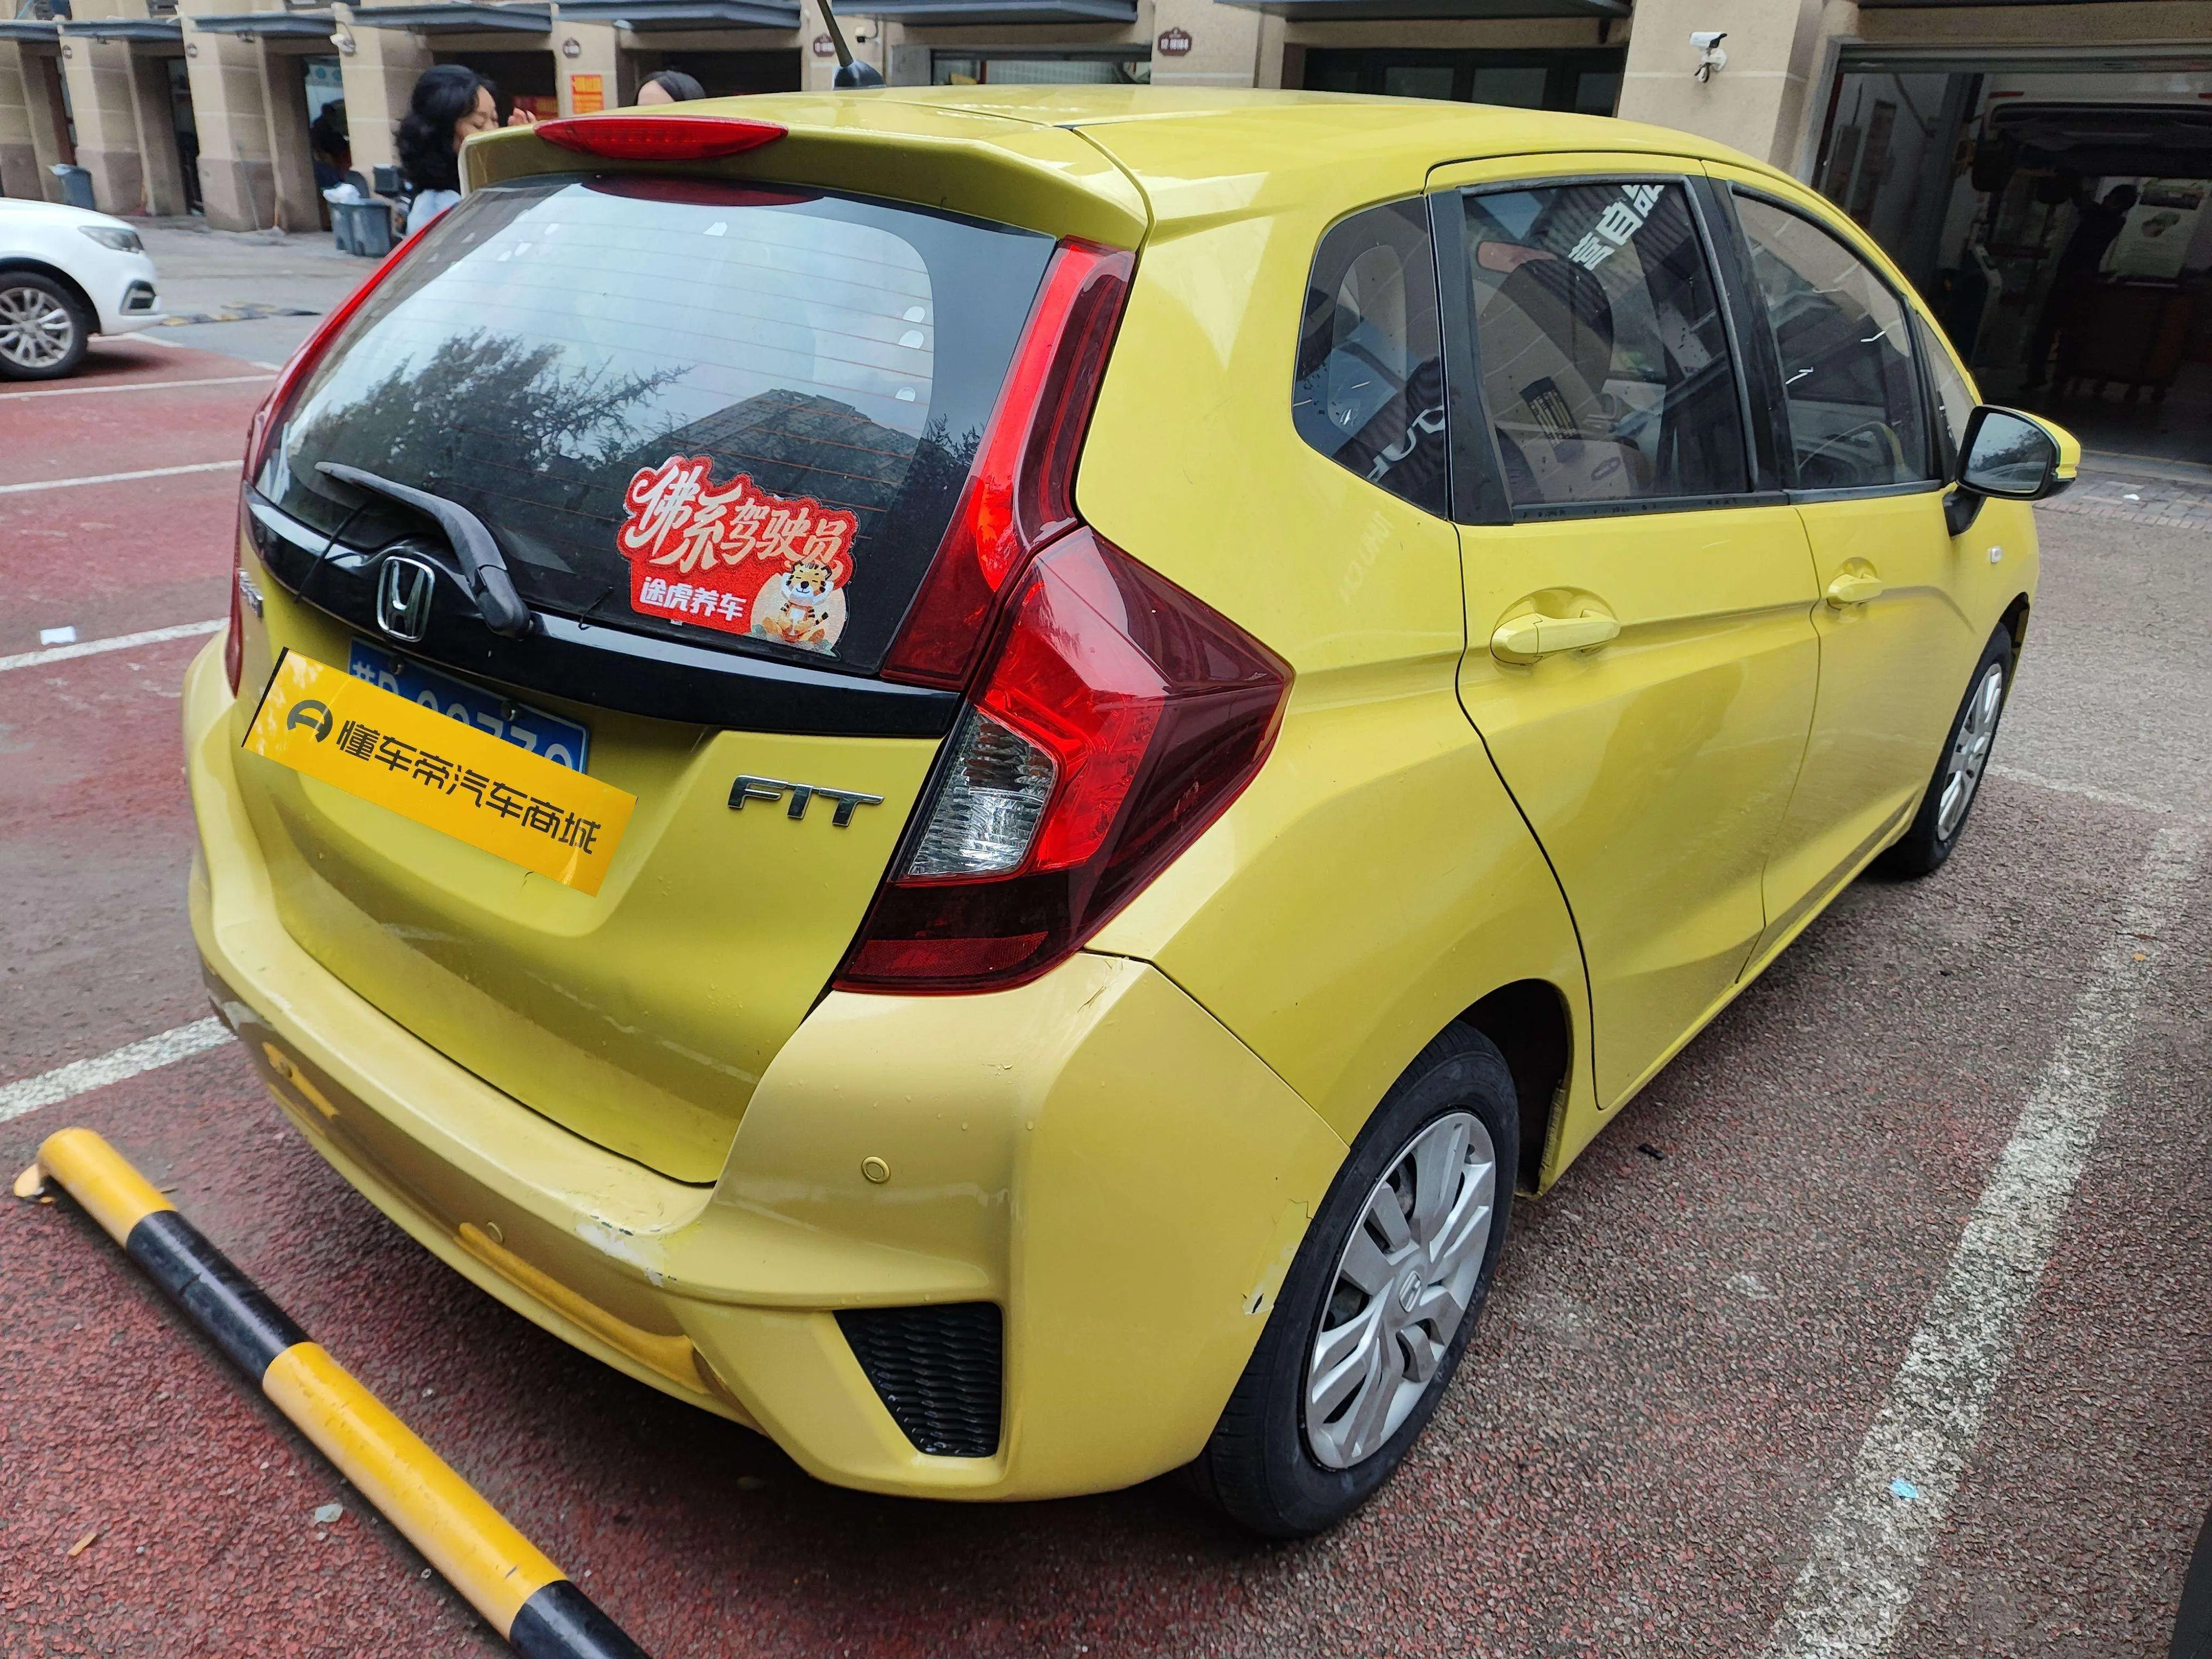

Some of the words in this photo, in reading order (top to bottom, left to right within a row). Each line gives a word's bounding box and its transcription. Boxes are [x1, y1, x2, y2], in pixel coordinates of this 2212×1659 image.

[625, 464, 847, 576] 佛系驾驶员
[639, 576, 748, 622] 途虎养车
[727, 774, 885, 828] FIT
